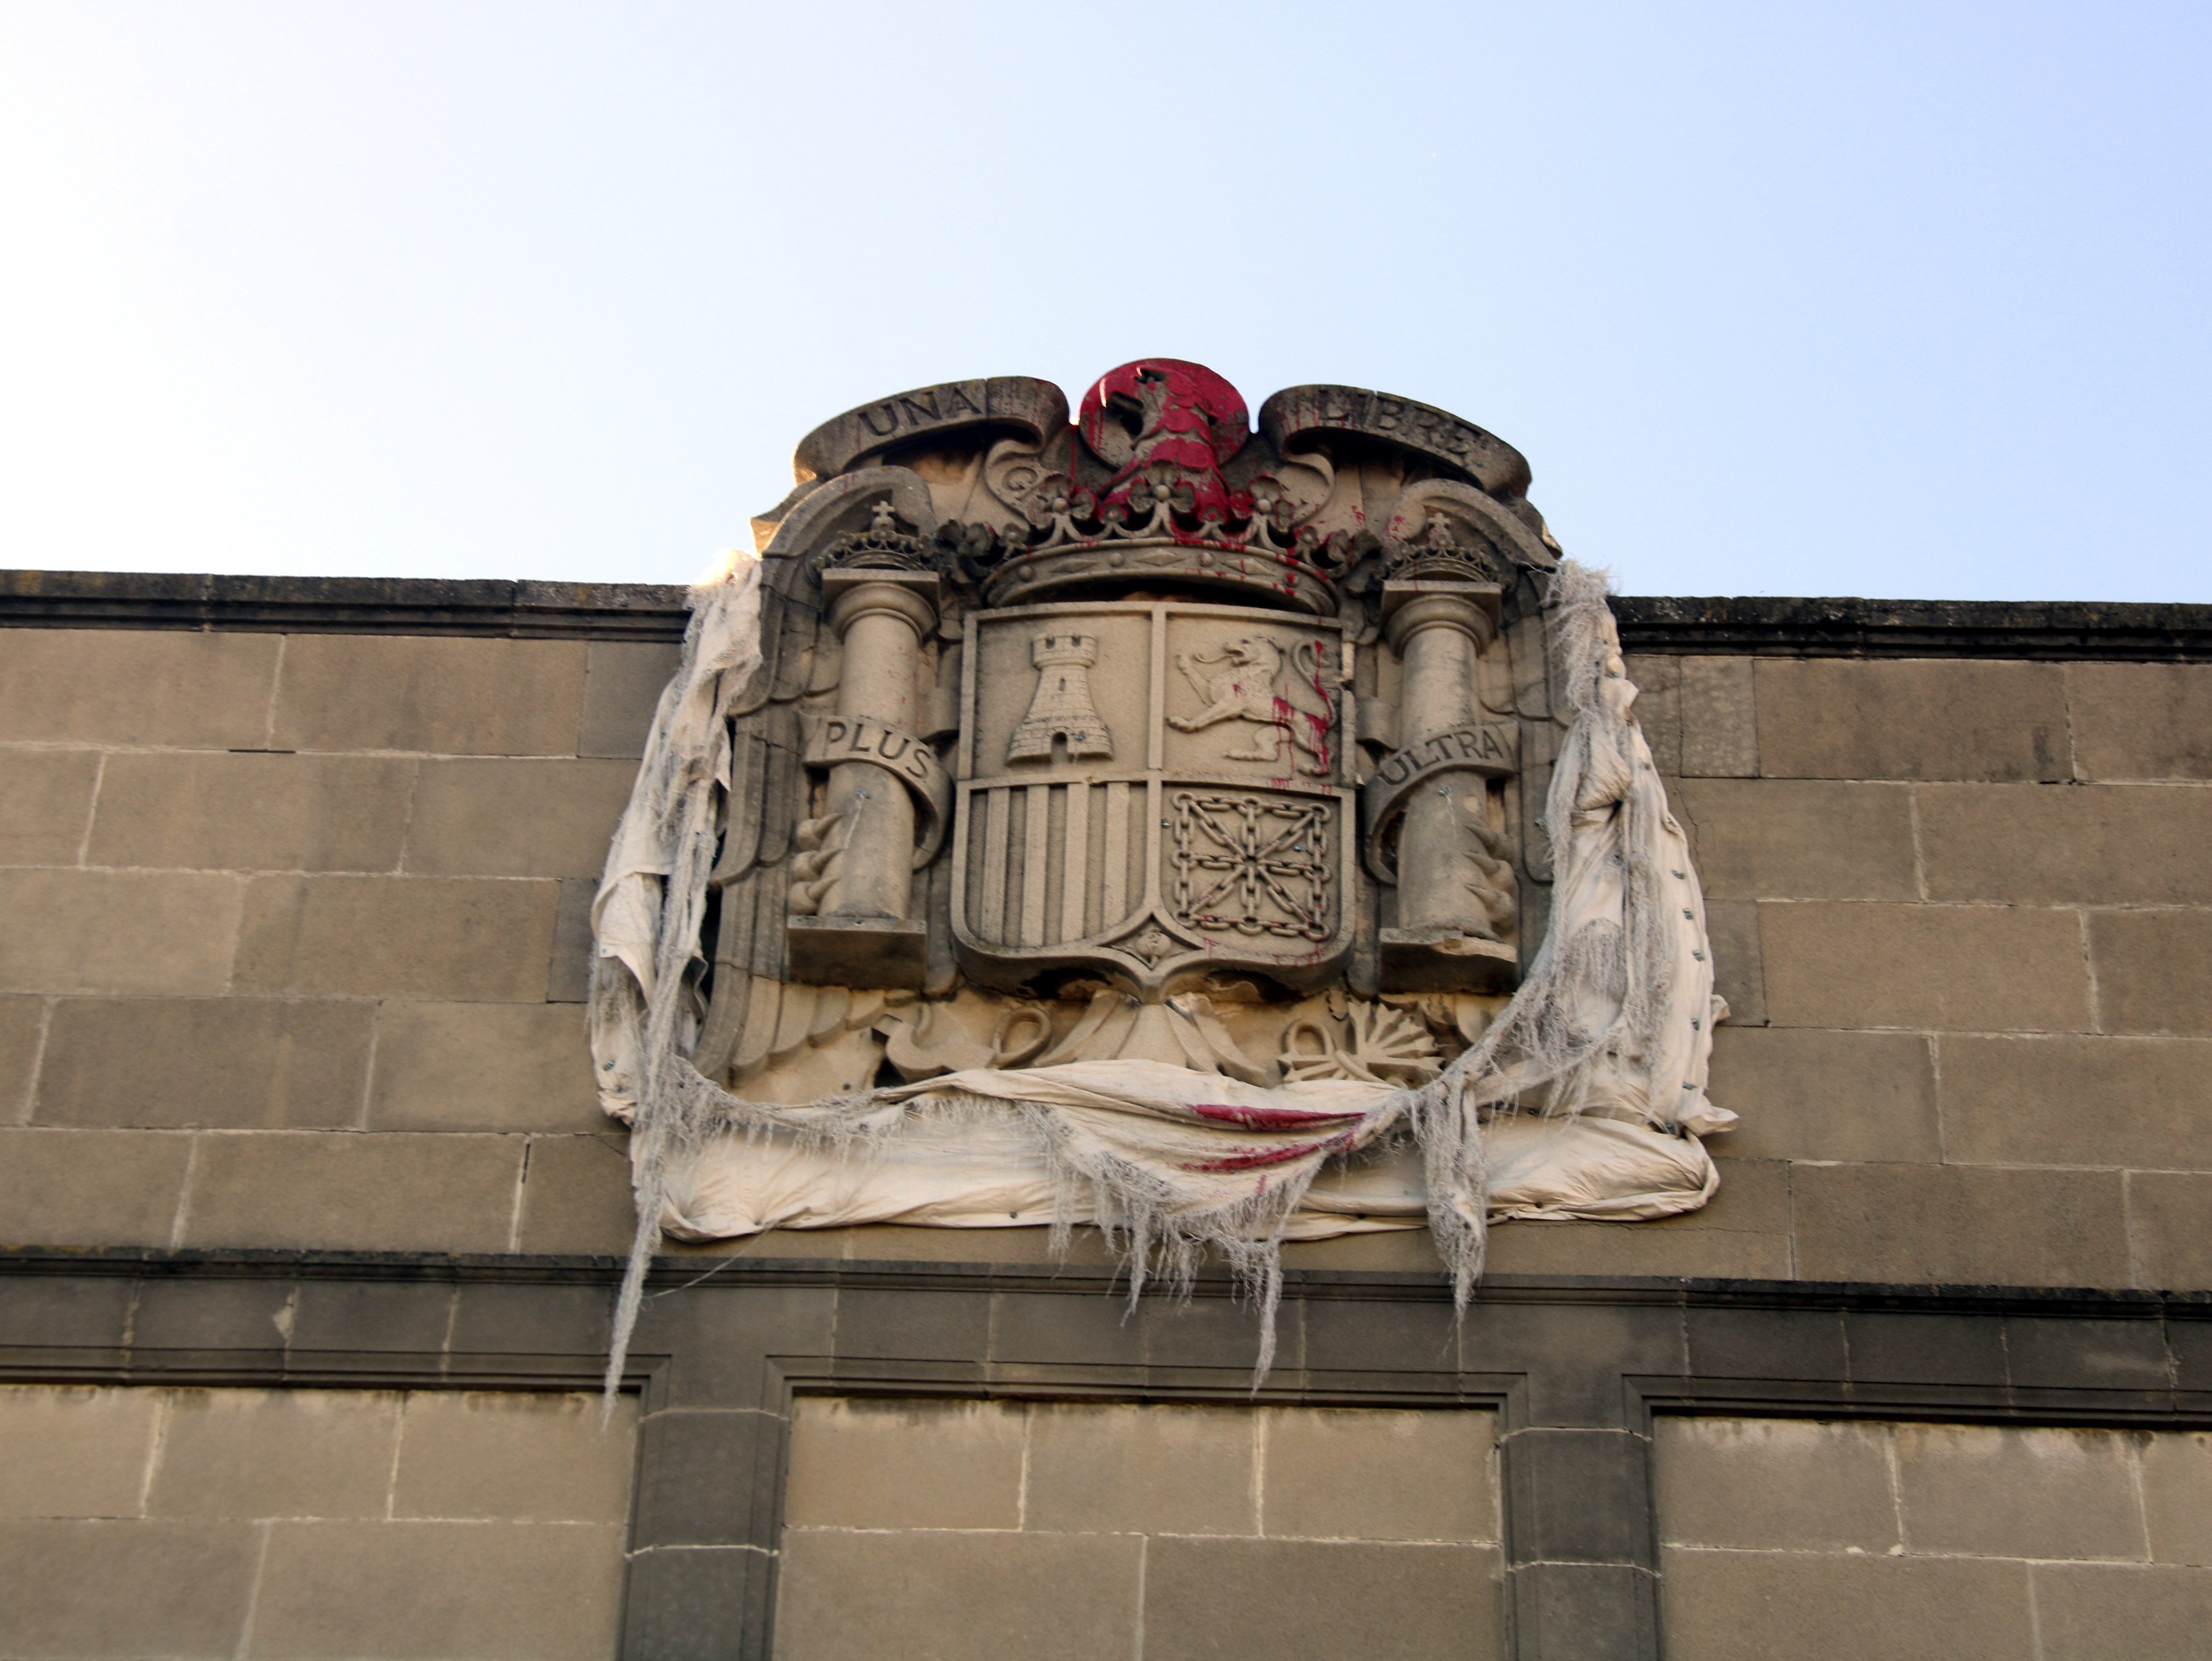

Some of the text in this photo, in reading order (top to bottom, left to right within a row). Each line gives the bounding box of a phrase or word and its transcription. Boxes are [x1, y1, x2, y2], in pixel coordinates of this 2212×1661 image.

[857, 386, 982, 437] UNA
[825, 721, 932, 778] PLUS
[1378, 729, 1504, 785] ULTRA
